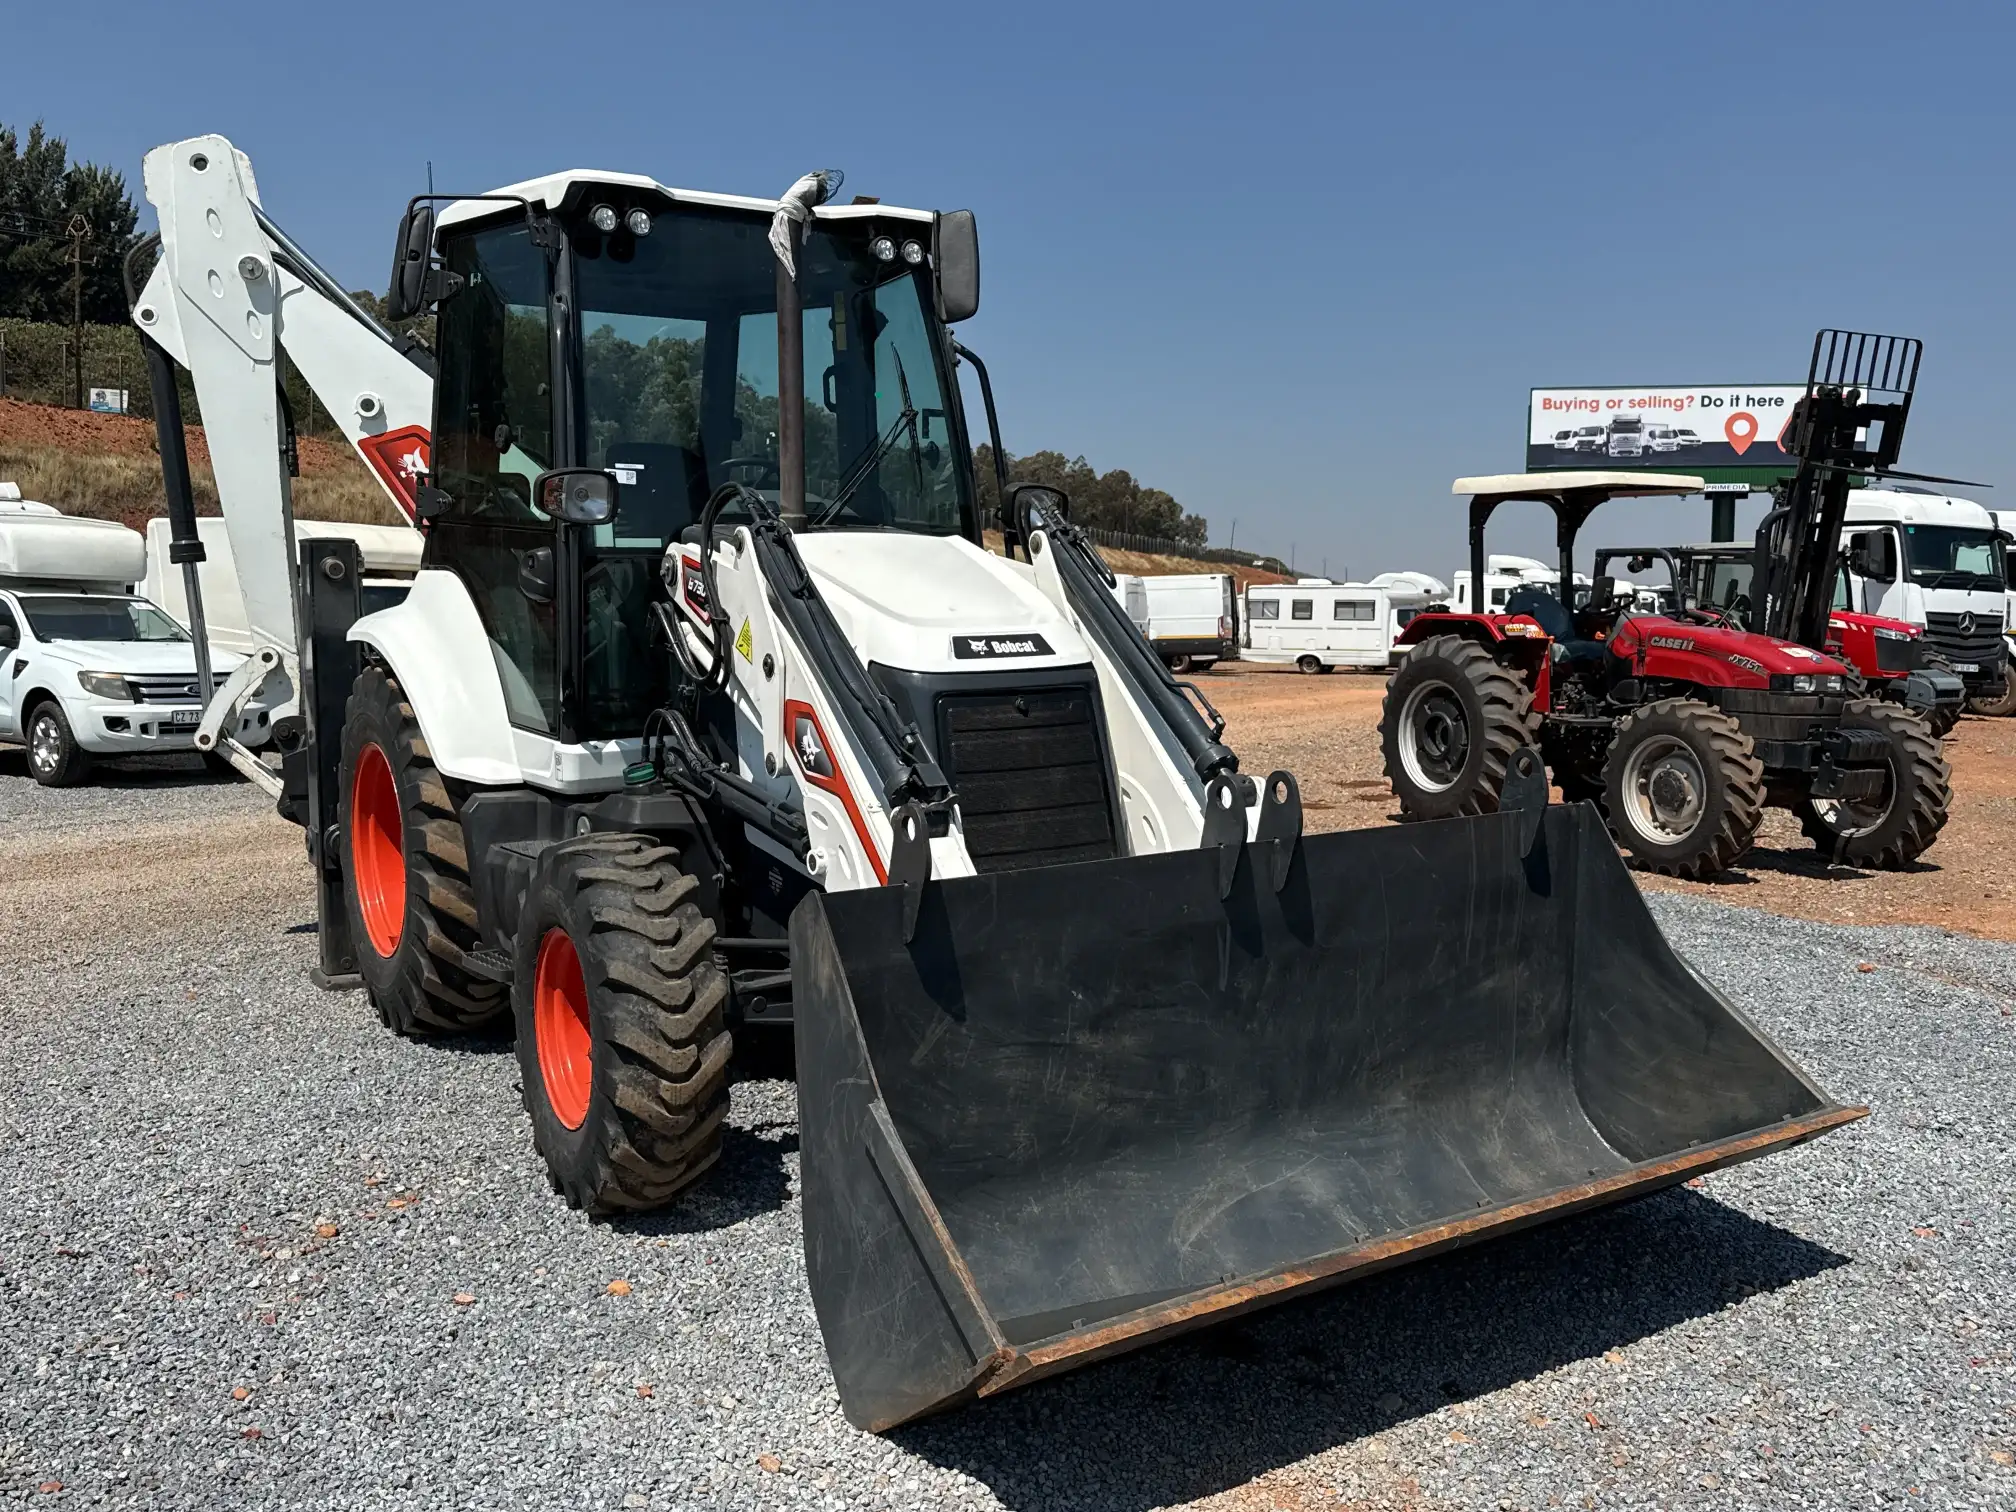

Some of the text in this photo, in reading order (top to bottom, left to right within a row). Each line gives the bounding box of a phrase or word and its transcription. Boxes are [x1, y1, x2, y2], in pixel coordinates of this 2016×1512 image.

[1542, 394, 1785, 413] Buying or selling? Do it here
[990, 640, 1037, 654] Bobcat
[175, 712, 186, 722] CZ
